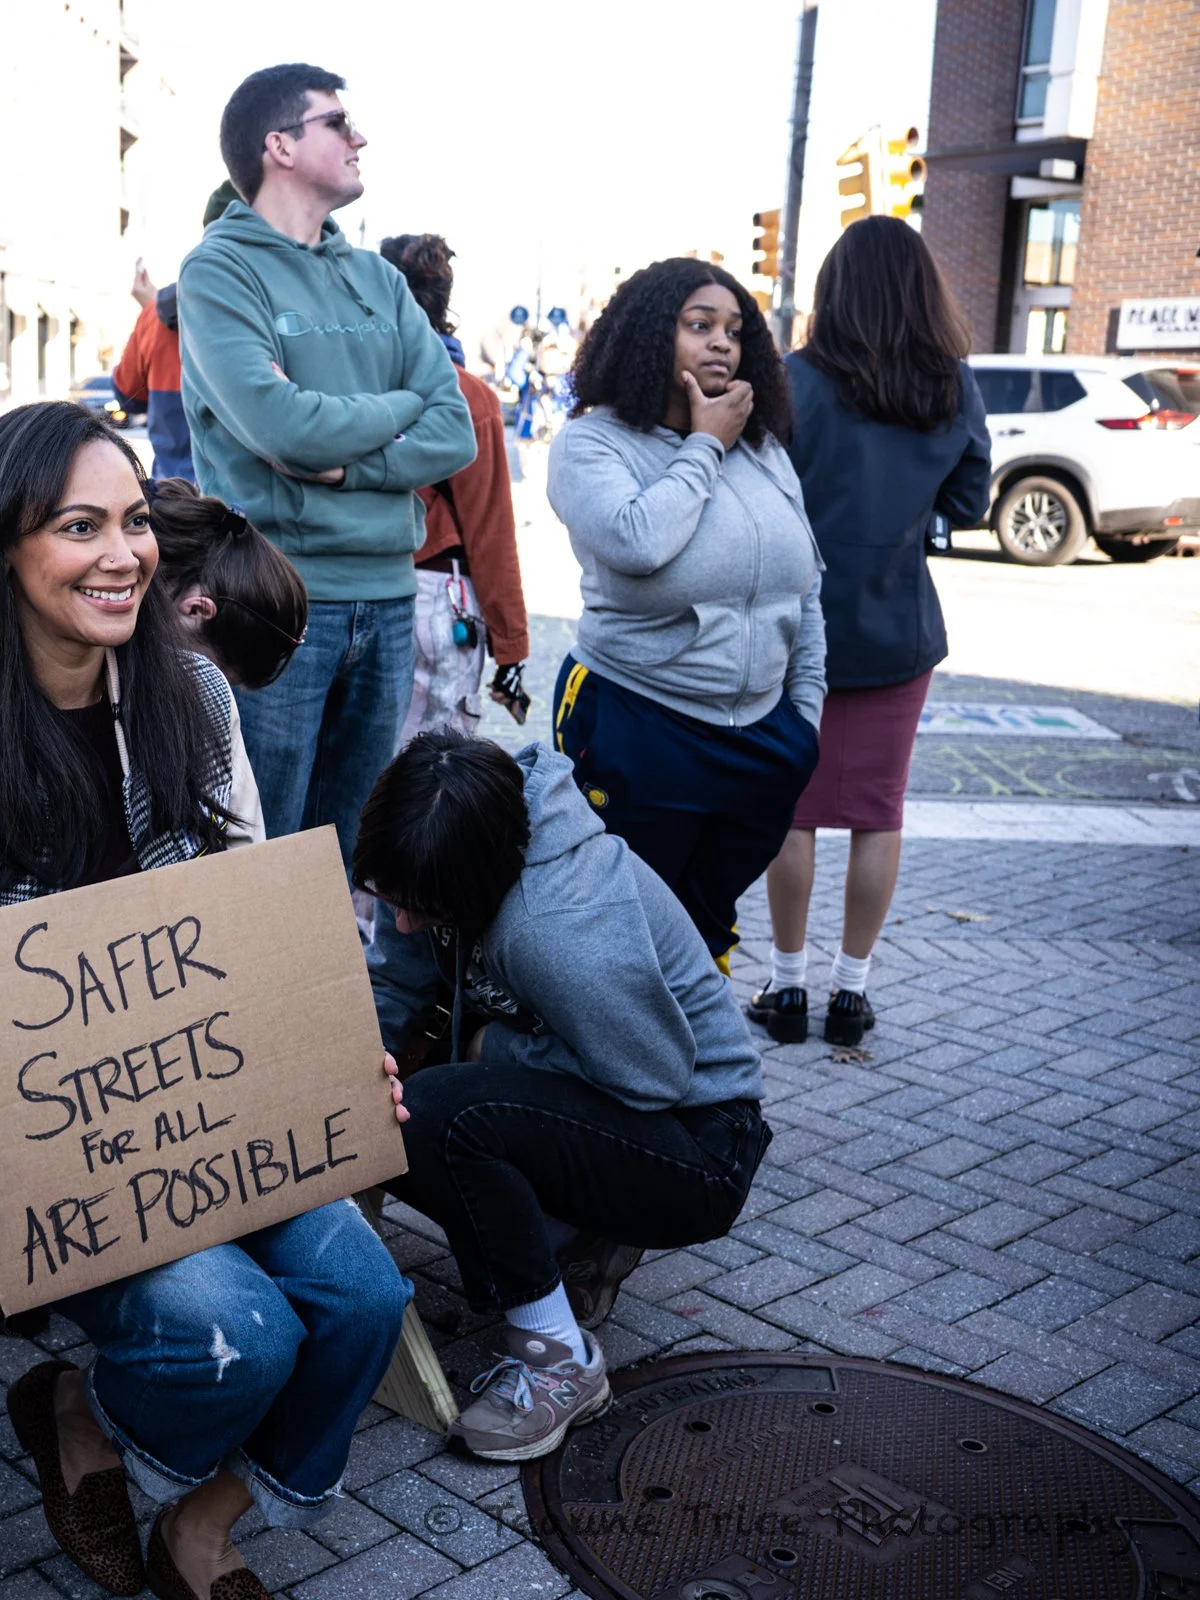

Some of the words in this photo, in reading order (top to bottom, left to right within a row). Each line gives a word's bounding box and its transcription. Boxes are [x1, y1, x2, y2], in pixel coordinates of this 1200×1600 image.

[12, 916, 227, 1030] SAFER
[17, 1011, 244, 1140] STREETS
[22, 1187, 121, 1286] ARE
[126, 1108, 358, 1243] POSSIBLE
[81, 1128, 141, 1174] FOR
[155, 1102, 237, 1151] ALL
